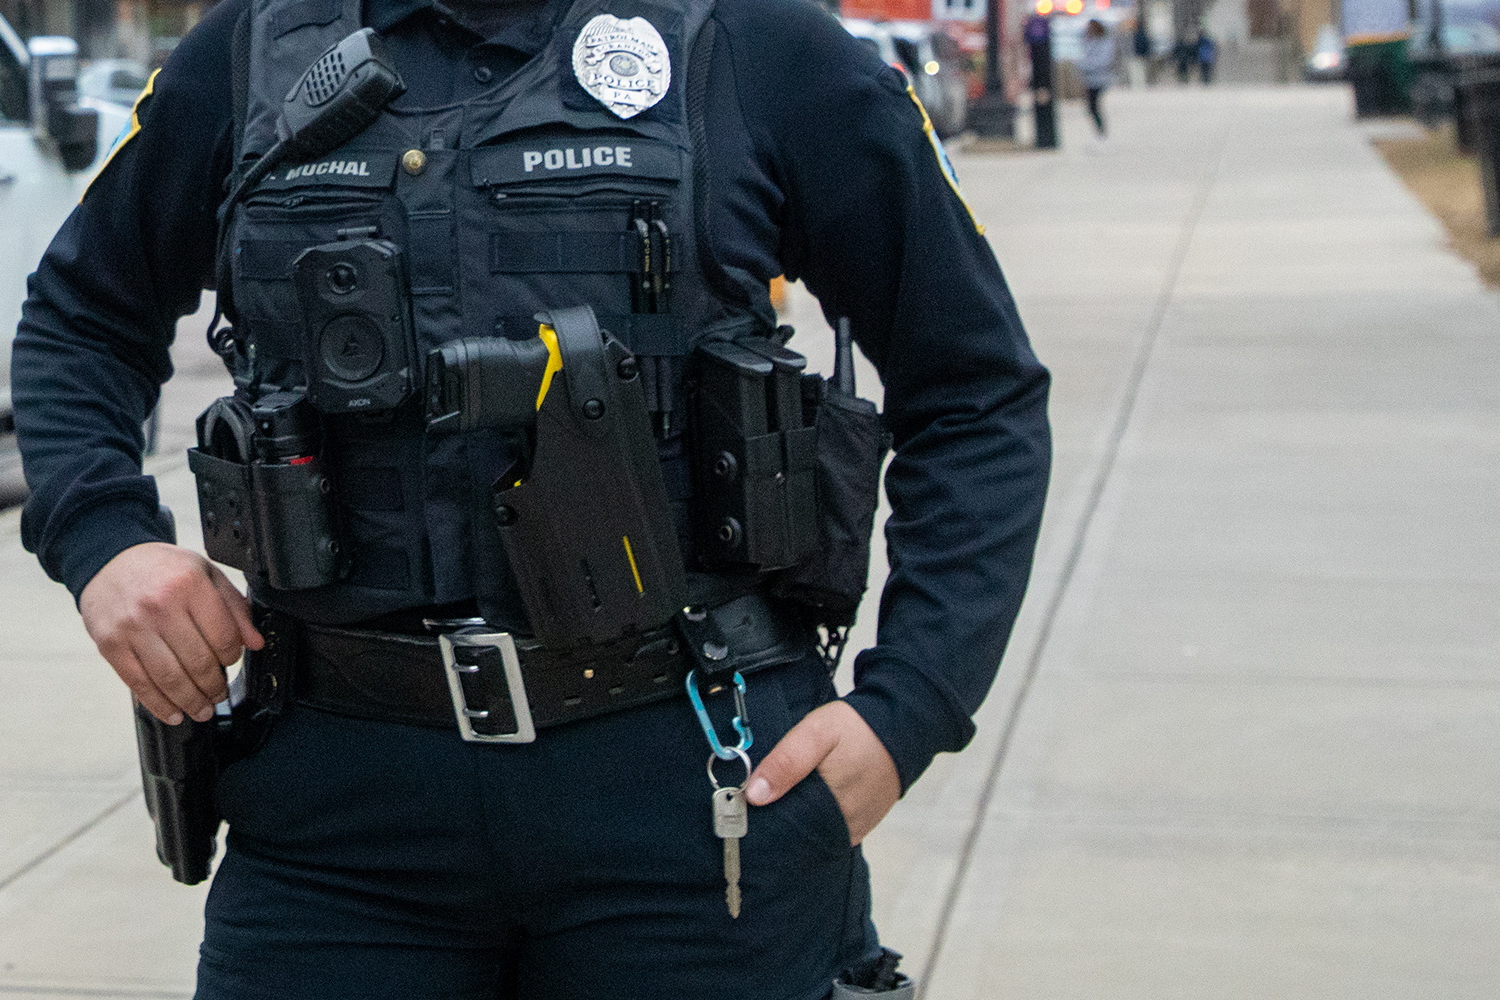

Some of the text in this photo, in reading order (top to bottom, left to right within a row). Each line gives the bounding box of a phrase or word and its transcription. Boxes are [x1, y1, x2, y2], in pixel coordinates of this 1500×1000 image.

[593, 73, 656, 89] POLICE
[614, 91, 632, 100] PA
[523, 146, 633, 173] POLICE
[285, 160, 371, 181] MUCHAL
